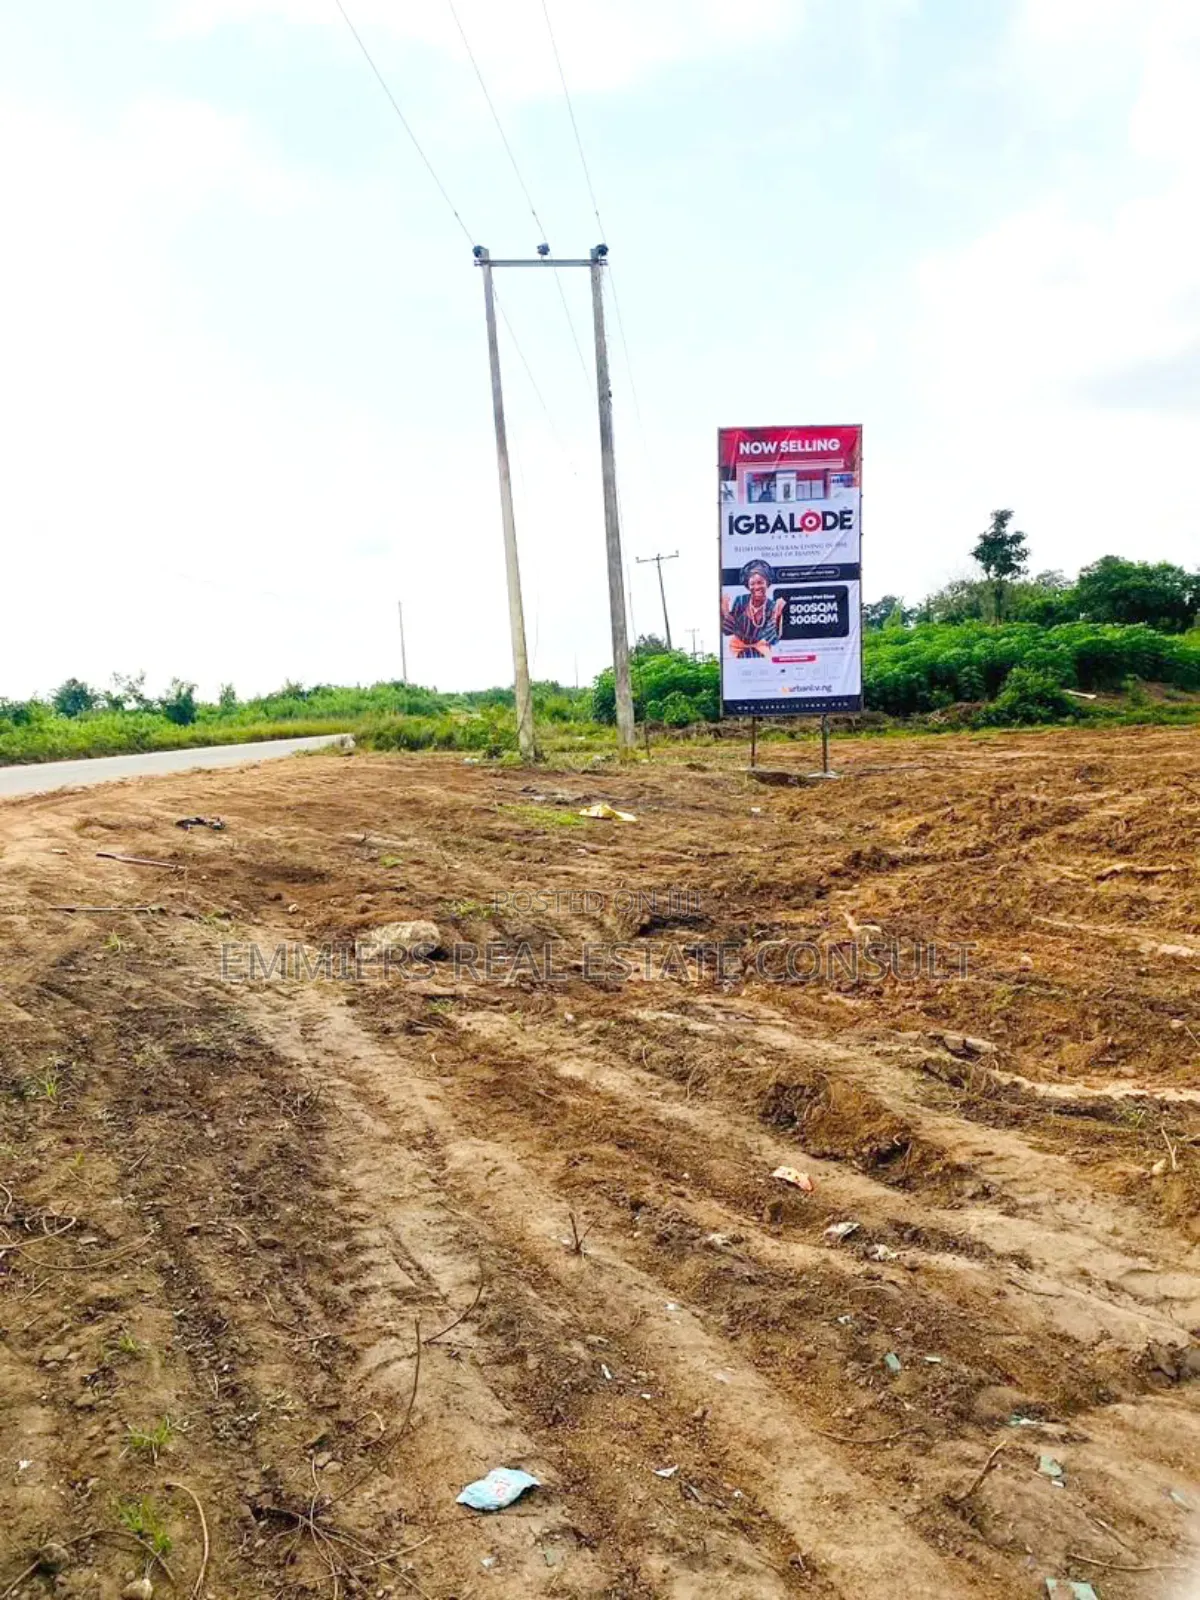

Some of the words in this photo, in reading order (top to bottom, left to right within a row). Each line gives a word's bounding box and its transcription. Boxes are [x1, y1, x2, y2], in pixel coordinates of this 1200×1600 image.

[739, 441, 777, 455] NOW
[780, 438, 840, 452] SELLING
[790, 602, 838, 614] 500SQM
[790, 613, 838, 625] 300SQM
